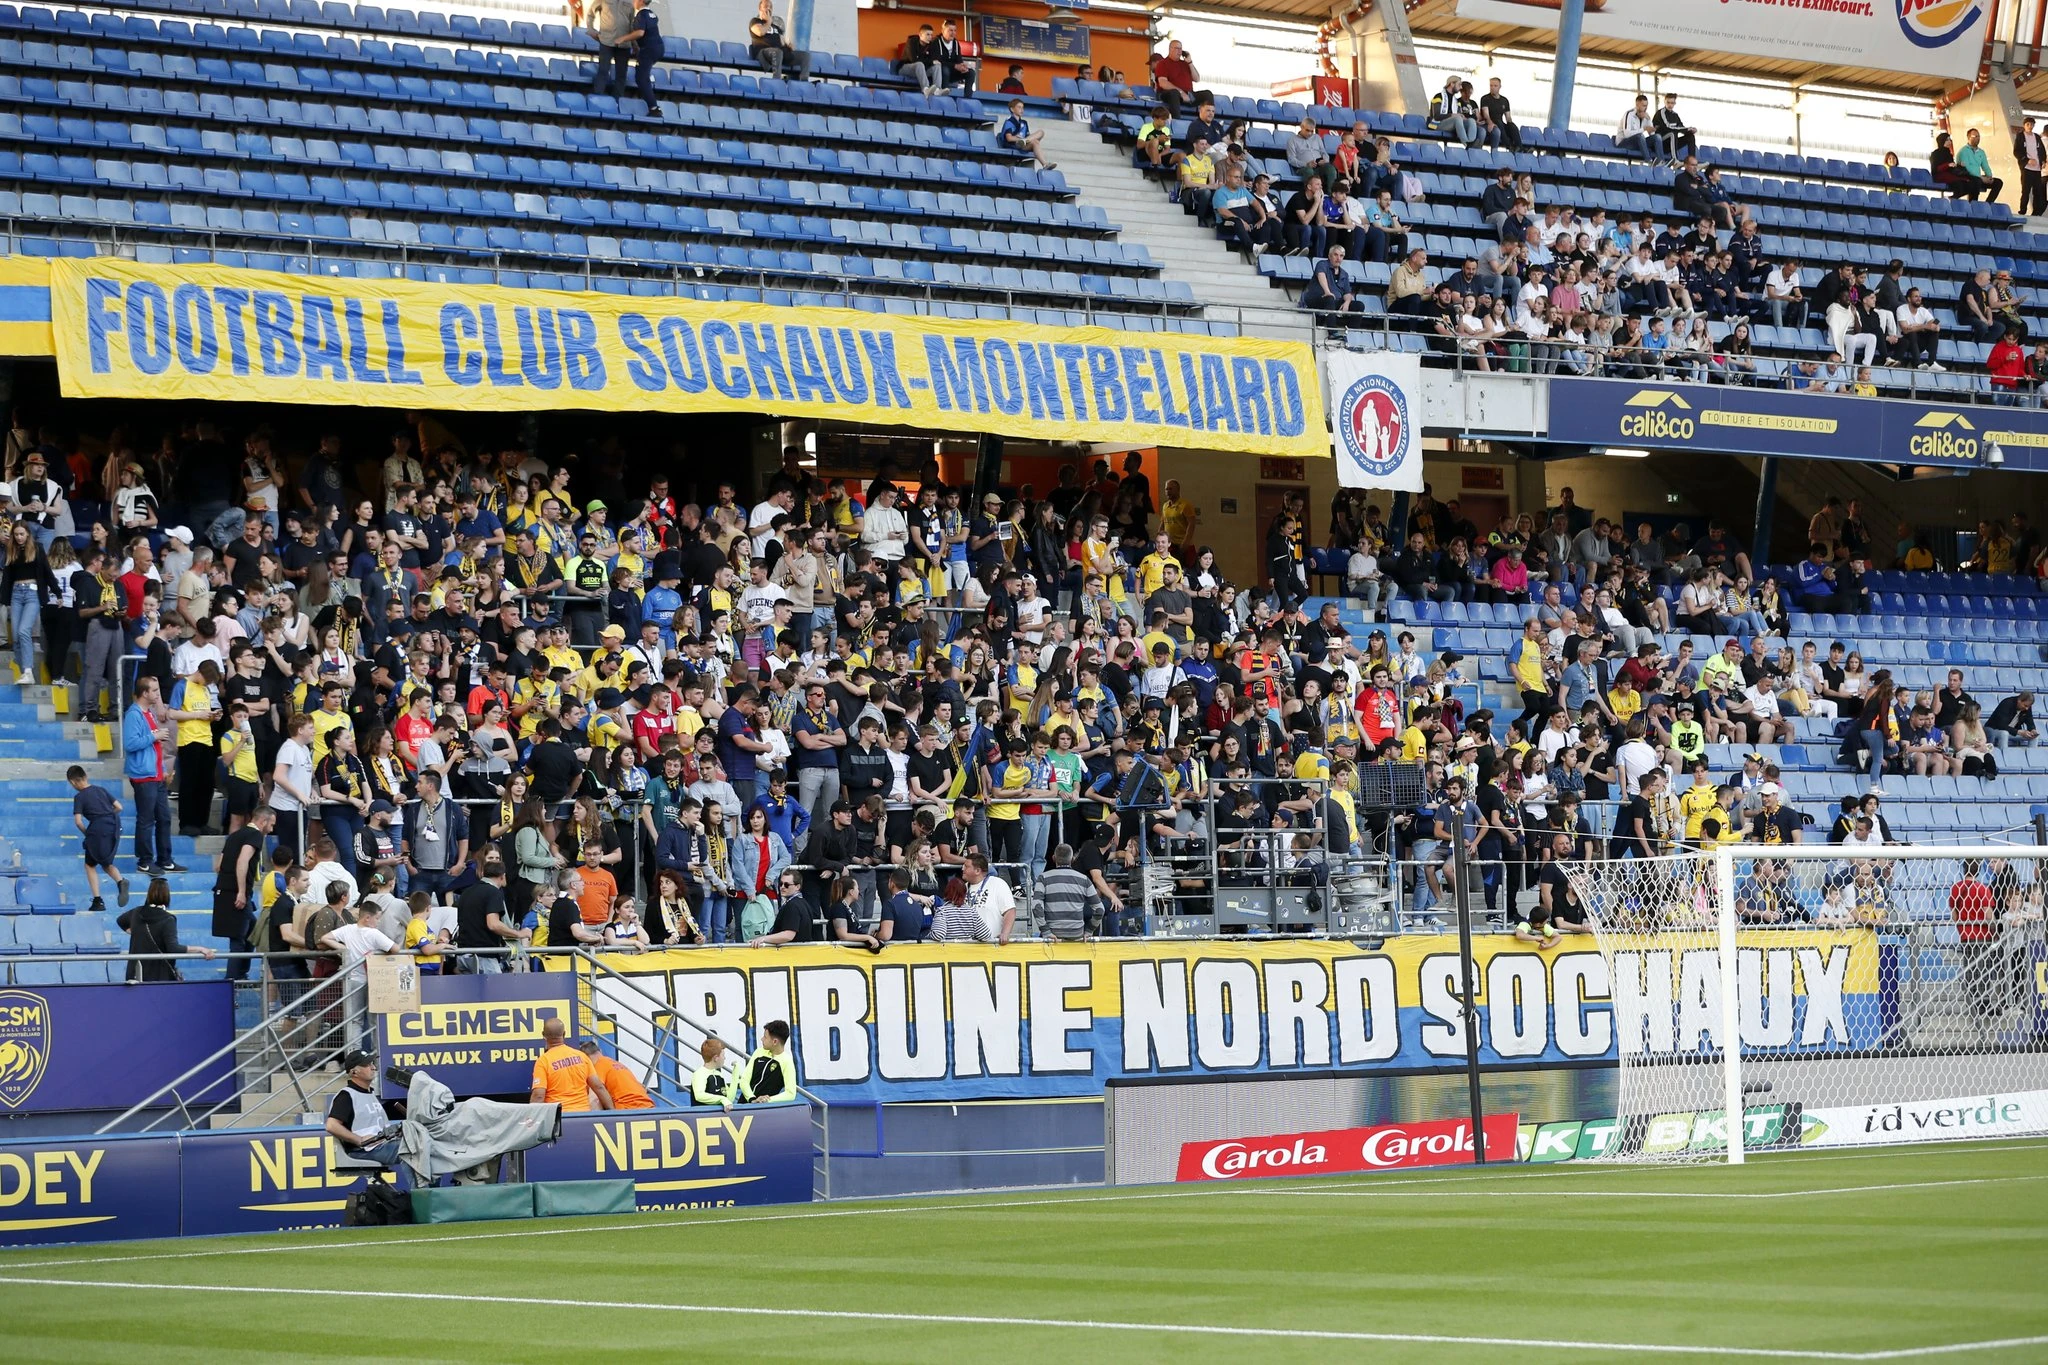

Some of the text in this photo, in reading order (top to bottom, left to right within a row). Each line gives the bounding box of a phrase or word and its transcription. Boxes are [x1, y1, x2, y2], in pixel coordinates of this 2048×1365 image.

[84, 277, 1307, 437] FOOTBALL CLUB SOCHAUX-MONTBELIARD
[1342, 393, 1360, 457] ASSOCIATION
[1353, 378, 1395, 395] NATIONALE
[1396, 398, 1408, 461] SUPPORTERS
[1619, 409, 1833, 440] cali&co TOITURE ET ISOLATION
[1909, 430, 2046, 460] cali&co TOITURE ET
[747, 598, 774, 609] QUEENS
[594, 944, 1852, 1094] TRIBUNE NORD SOCHAUX
[392, 1047, 545, 1067] TRAVAUX PUBLI
[551, 1055, 583, 1071] STADIER
[594, 1114, 755, 1173] NEDEY
[1650, 1112, 1782, 1148] BKT
[1201, 1138, 1328, 1179] Carola
